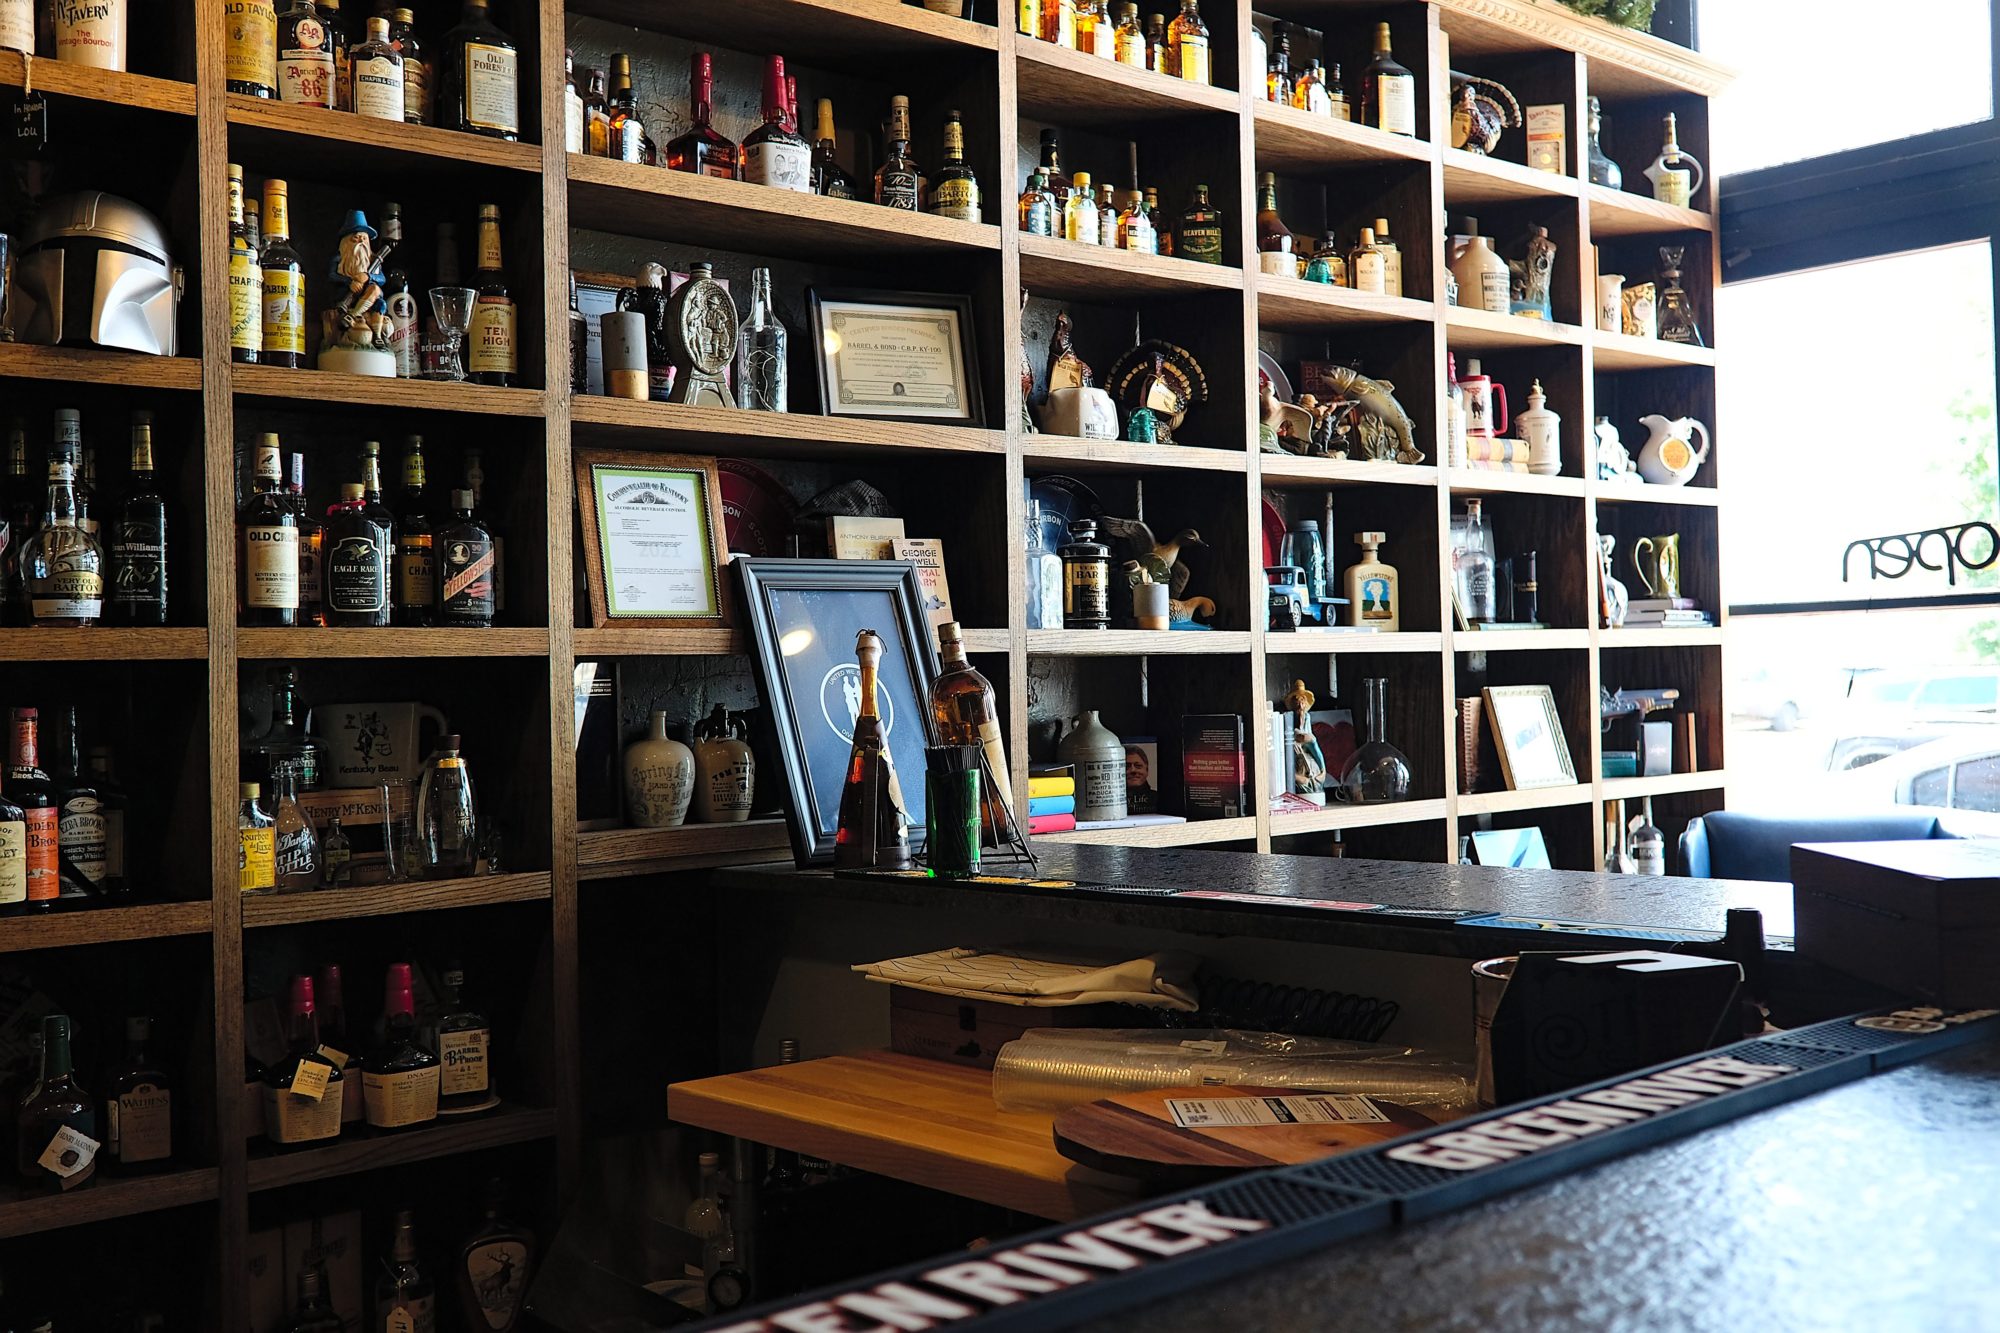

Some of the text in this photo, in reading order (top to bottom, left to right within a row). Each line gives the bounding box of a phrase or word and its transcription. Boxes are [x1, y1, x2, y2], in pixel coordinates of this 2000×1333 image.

[69, 5, 109, 26] TAVERN
[77, 30, 91, 38] The
[487, 53, 504, 64] OLD
[301, 79, 322, 97] 86
[17, 126, 38, 138] LOU
[1183, 229, 1205, 237] HEAVEN
[484, 326, 507, 336] TEN
[482, 336, 510, 347] HIGH
[847, 342, 873, 350] BARREL
[420, 342, 445, 353] ncient
[606, 482, 651, 503] COMMONWEALTH
[660, 482, 689, 505] KENTUCKY
[249, 532, 276, 543] OLD
[125, 542, 162, 552] Williams
[902, 549, 937, 558] GEORGE
[333, 565, 380, 573] EAGLE RARE
[57, 577, 98, 586] VERY OLD
[1357, 572, 1394, 582] YELLOWSTONE
[54, 583, 99, 593] BARTON
[828, 671, 845, 687] UNITED
[279, 759, 316, 768] FORESTER
[339, 764, 400, 775] Kentucky Beau
[711, 768, 732, 781] TOM
[1133, 794, 1149, 805] Life
[304, 805, 342, 819] HENRY
[278, 849, 302, 866] TIP
[278, 852, 312, 875] OTTLE
[407, 1072, 424, 1080] DNA
[1387, 1056, 1795, 1171] GREEN RIVER
[58, 1130, 75, 1144] HENRY
[925, 1200, 1270, 1305] RIVER
